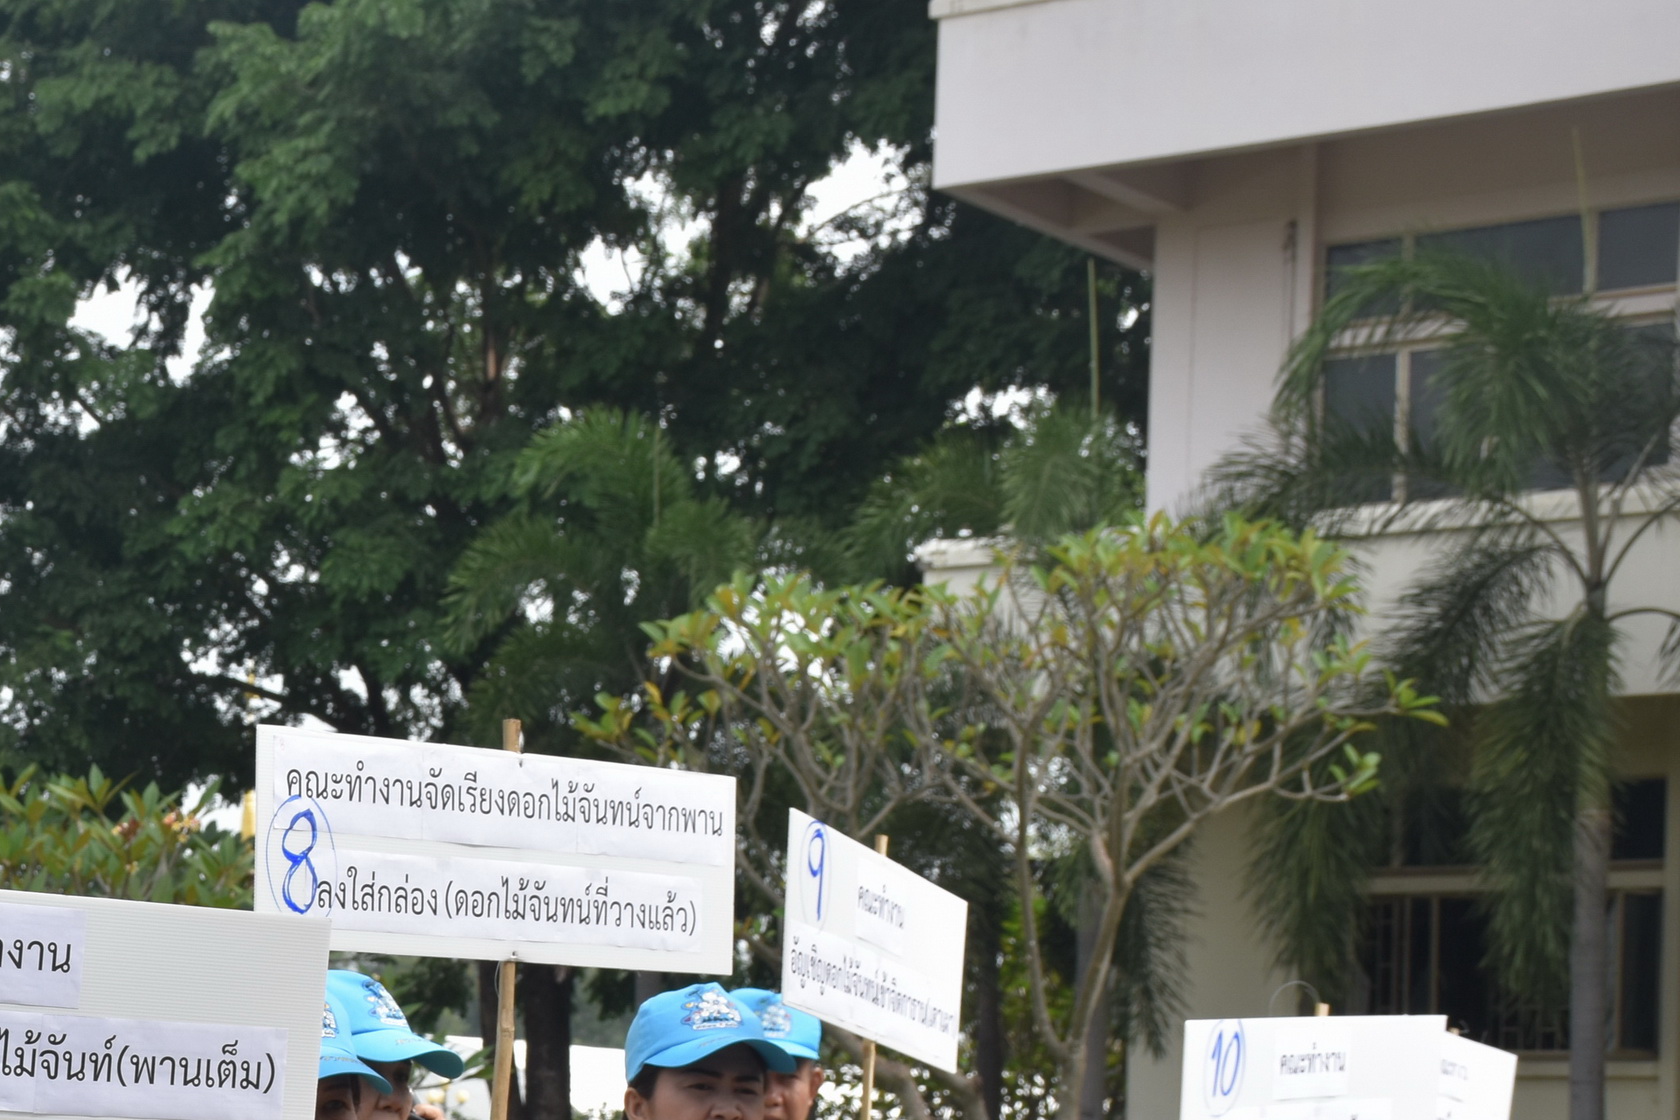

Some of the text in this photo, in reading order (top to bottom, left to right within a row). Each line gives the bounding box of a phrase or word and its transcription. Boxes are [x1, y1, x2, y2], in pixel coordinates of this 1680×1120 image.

[286, 760, 724, 838] คณะทำงานจัดเรียงดอกไม้จันทน์จากพาน
[282, 808, 318, 914] 8
[1211, 1030, 1242, 1097] 10
